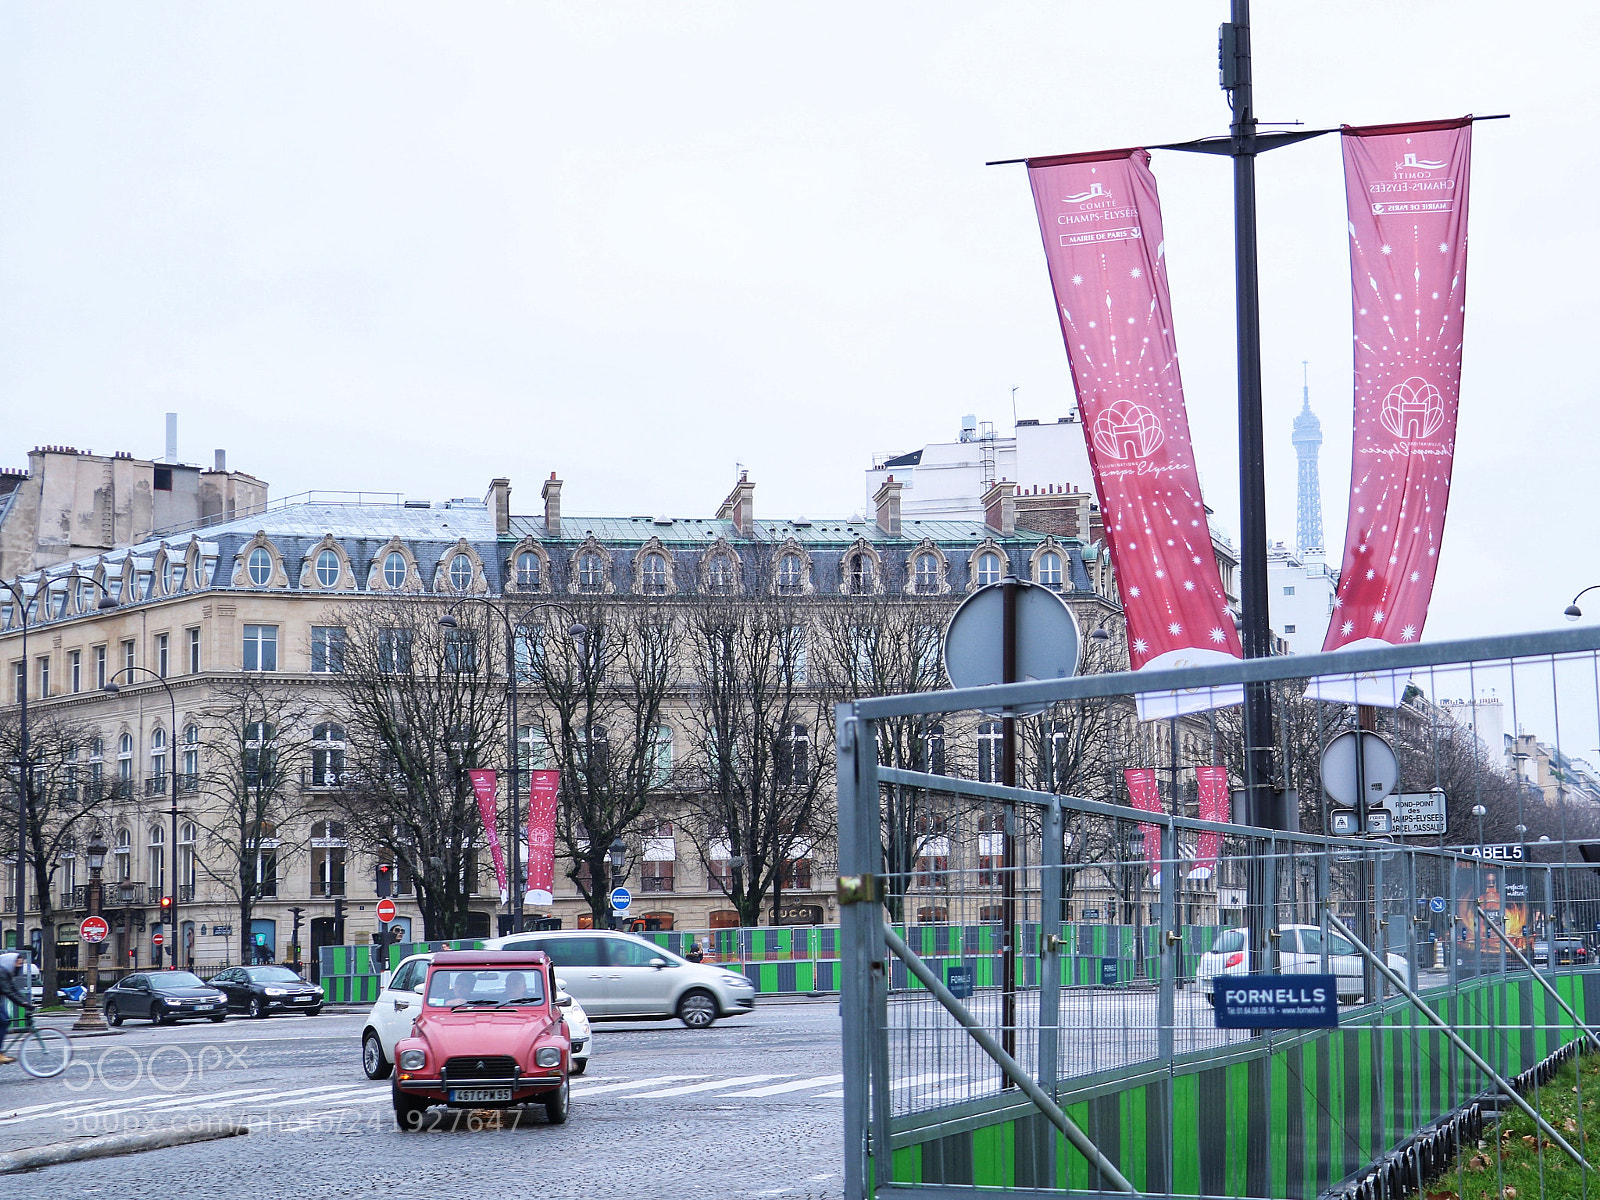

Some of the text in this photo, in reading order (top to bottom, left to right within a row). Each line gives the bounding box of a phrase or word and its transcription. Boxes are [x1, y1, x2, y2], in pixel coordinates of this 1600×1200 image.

[1069, 234, 1096, 243] MAIRIE
[1392, 814, 1444, 823] HAMPS-ELYSEES
[1225, 988, 1326, 1004] FORNELLS
